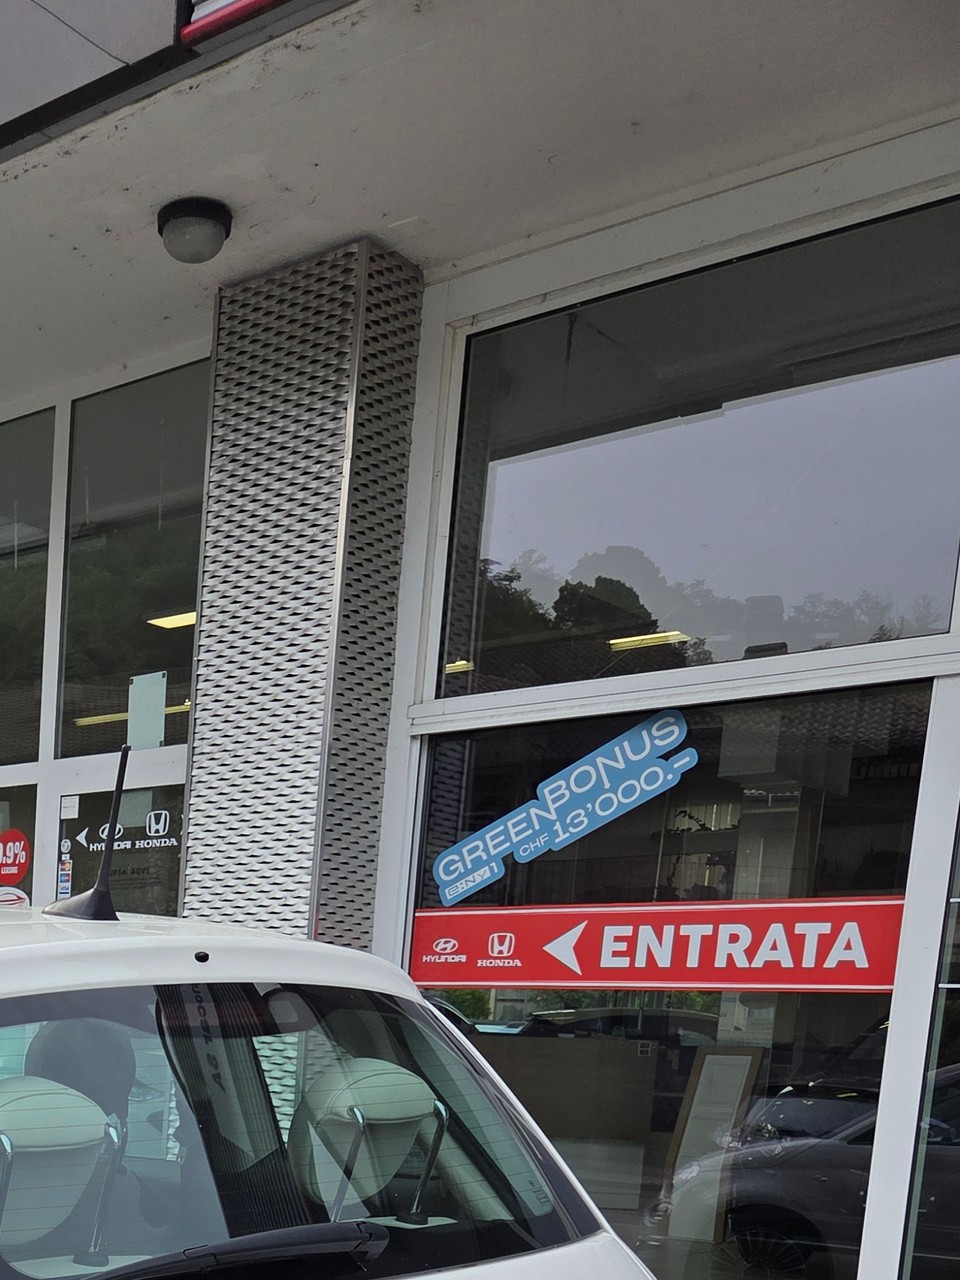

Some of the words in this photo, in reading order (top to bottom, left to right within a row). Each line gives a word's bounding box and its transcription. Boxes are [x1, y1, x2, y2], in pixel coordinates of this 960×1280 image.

[438, 804, 557, 882] GREEN
[543, 716, 680, 814] BONUS
[89, 840, 132, 852] HYDAI
[135, 837, 178, 849] HONDA
[519, 832, 550, 857] CHF
[599, 921, 869, 969] ENTRATA
[422, 954, 467, 963] HYUNDAI
[476, 959, 522, 967] HONDA
